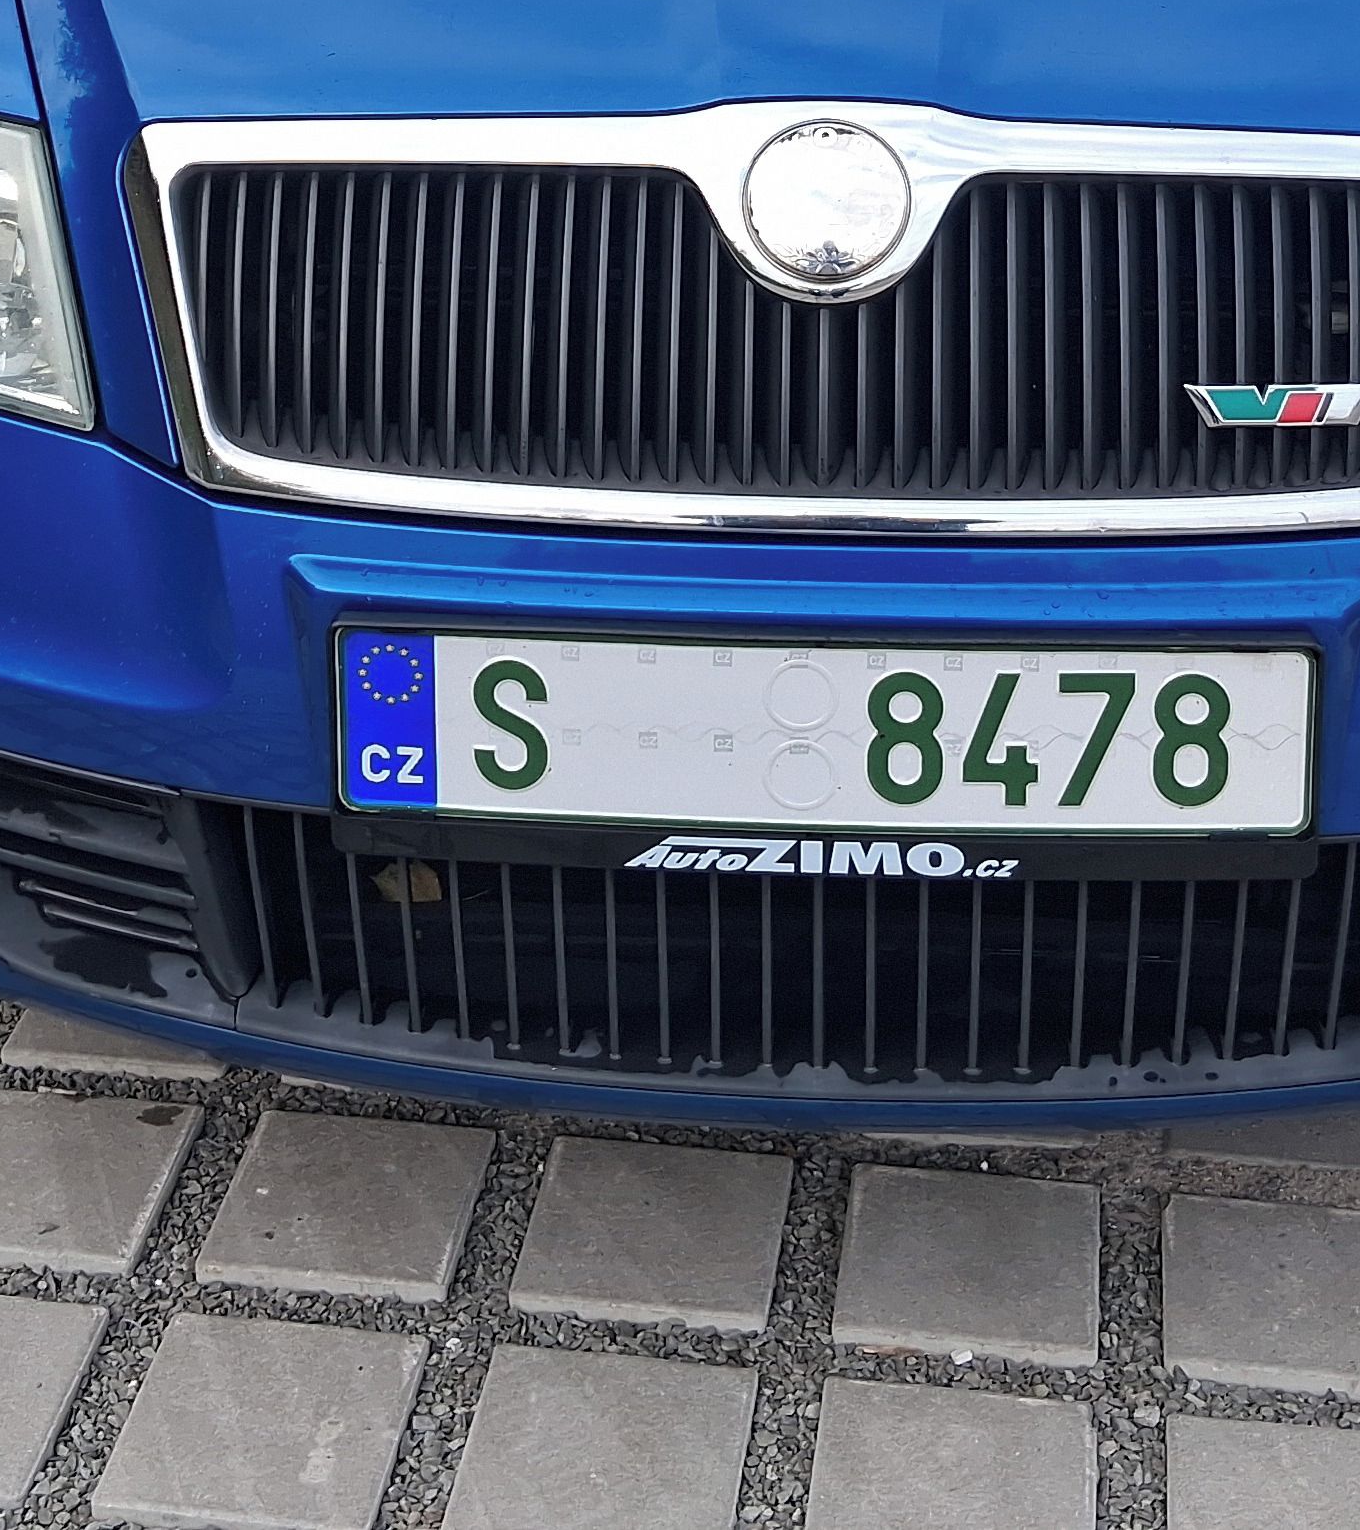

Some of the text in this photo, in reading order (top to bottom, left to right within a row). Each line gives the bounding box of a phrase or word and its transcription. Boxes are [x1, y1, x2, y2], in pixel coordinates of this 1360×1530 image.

[361, 744, 424, 784] CZ
[473, 658, 1231, 807] S 8478
